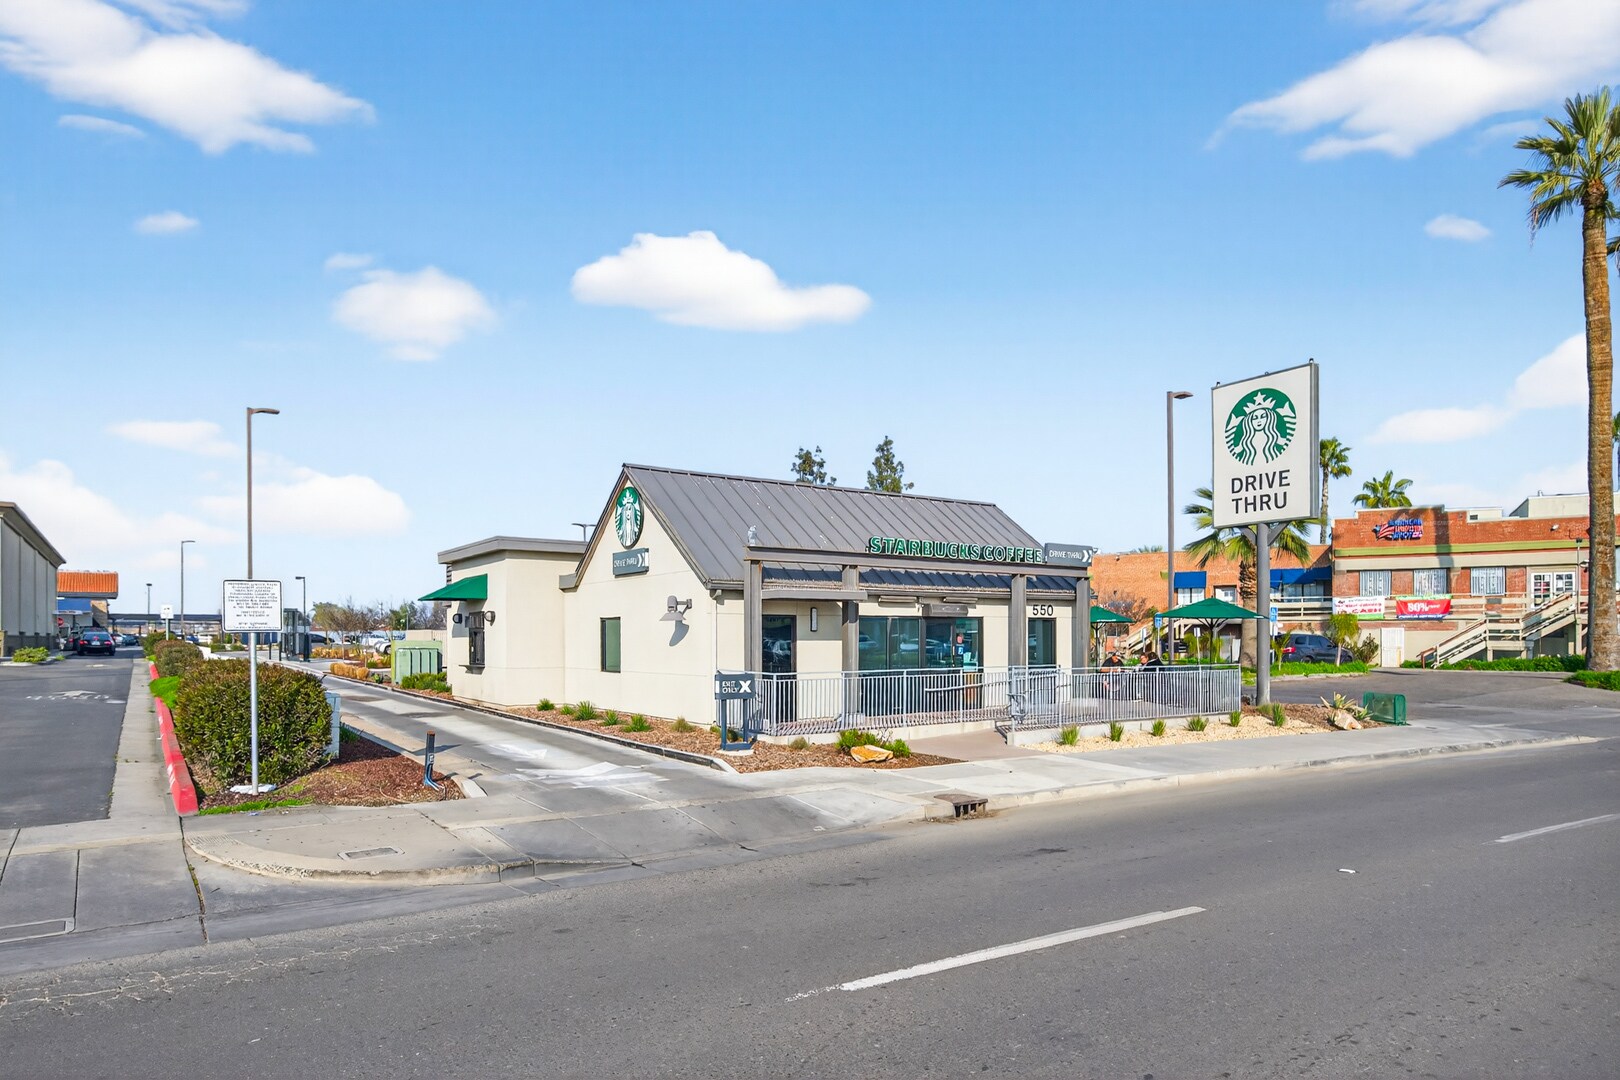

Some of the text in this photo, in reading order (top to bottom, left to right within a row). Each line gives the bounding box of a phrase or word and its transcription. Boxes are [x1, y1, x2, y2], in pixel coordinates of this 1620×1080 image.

[1231, 469, 1291, 494] DRIVE
[1231, 491, 1287, 514] THRU
[869, 536, 1043, 564] STARBUCKS COFFEE
[1032, 604, 1054, 616] 550
